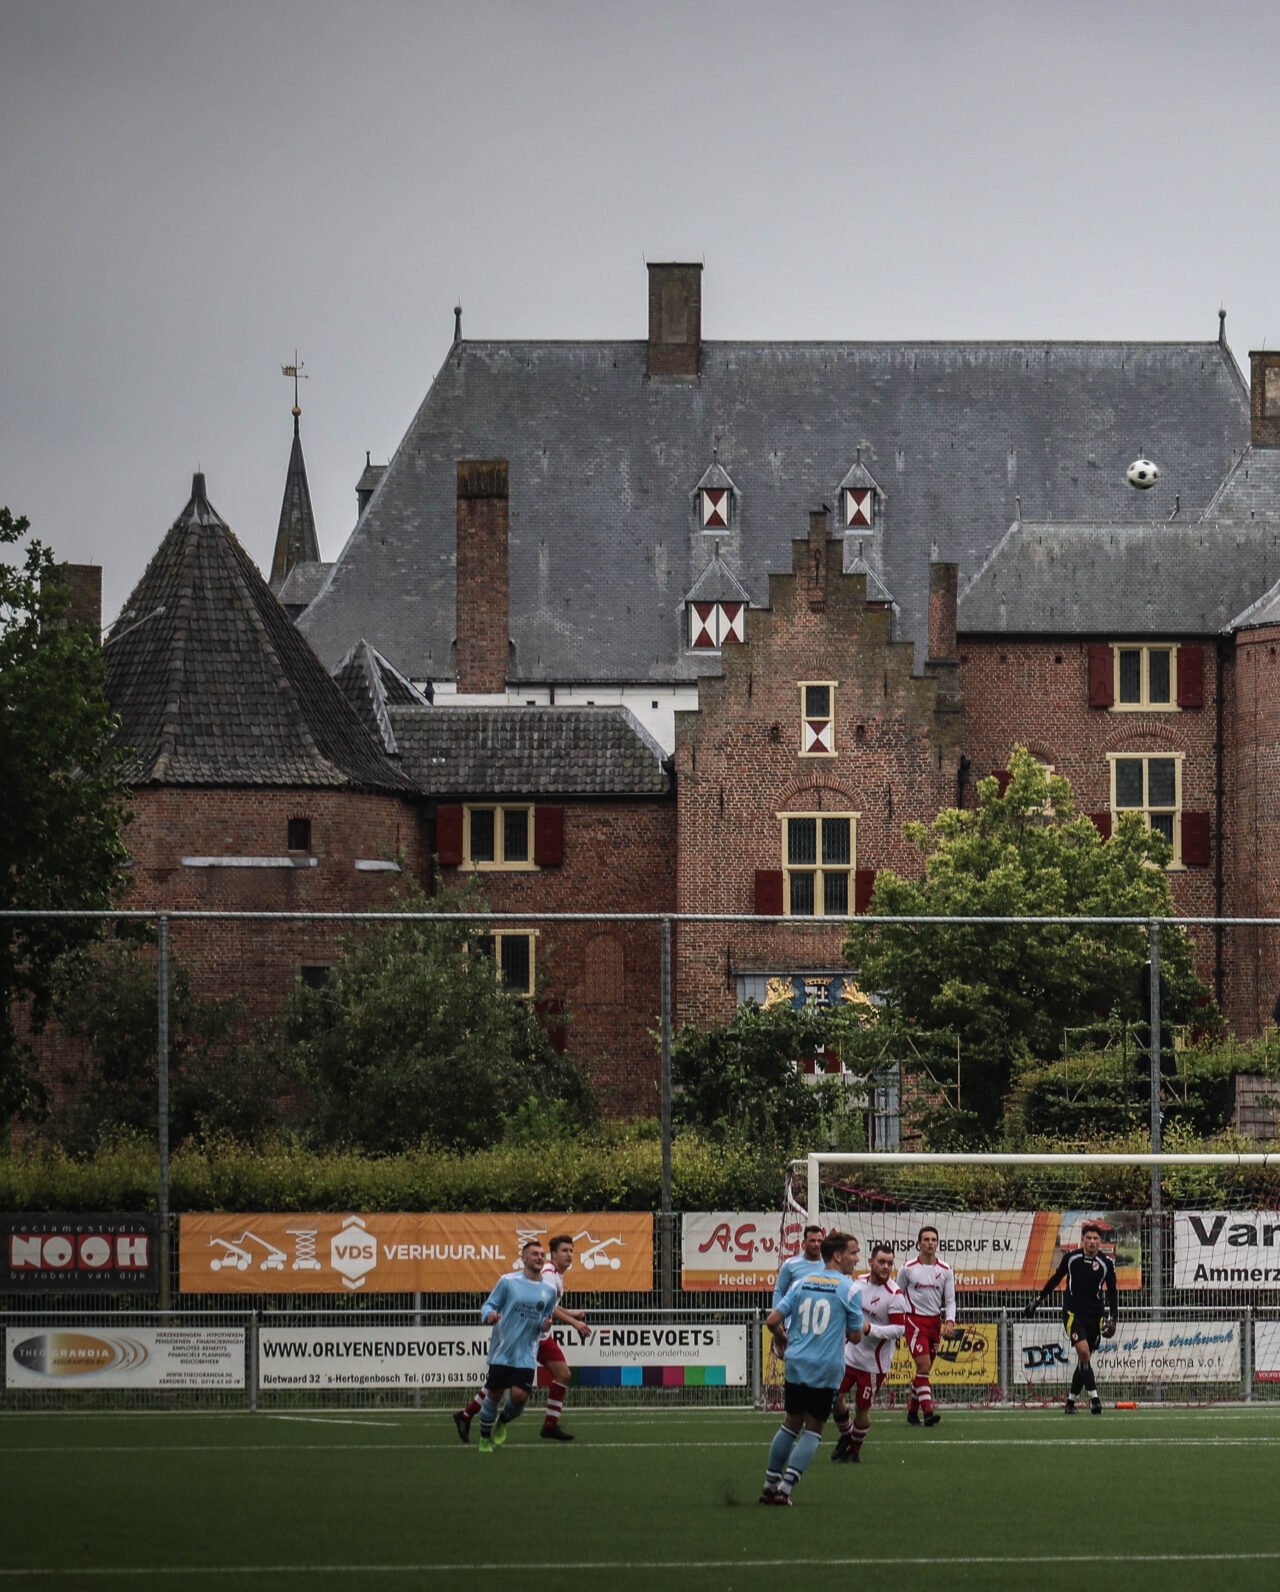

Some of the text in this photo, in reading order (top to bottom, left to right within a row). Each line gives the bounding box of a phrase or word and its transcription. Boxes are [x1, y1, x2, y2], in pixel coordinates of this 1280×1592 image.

[11, 1224, 146, 1233] reclamestudio
[11, 1234, 149, 1269] NOOH
[334, 1244, 506, 1260] VDS VERHUUR.NL
[992, 1239, 1013, 1252] B.V.
[10, 1271, 25, 1280] by
[34, 1271, 79, 1280] robert
[87, 1272, 111, 1280] van
[719, 1273, 757, 1285] Hedel
[955, 1273, 995, 1286] ffen.nl
[798, 1297, 831, 1336] 10
[553, 1329, 714, 1346] RLY/ENDEVOETS
[262, 1341, 488, 1358] WWW.ORLYENENDEVOETS.NL
[599, 1350, 655, 1358] buitengewoon
[1097, 1345, 1118, 1355] oor
[1096, 1356, 1224, 1369] drukkerij rokema v.o.f.
[263, 1374, 307, 1383] Rietwaard
[308, 1374, 321, 1383] 32
[404, 1373, 419, 1382] Tel.
[421, 1372, 446, 1384] (073)
[447, 1373, 464, 1382] 631
[466, 1373, 478, 1382] 50
[862, 1386, 871, 1400] 6
